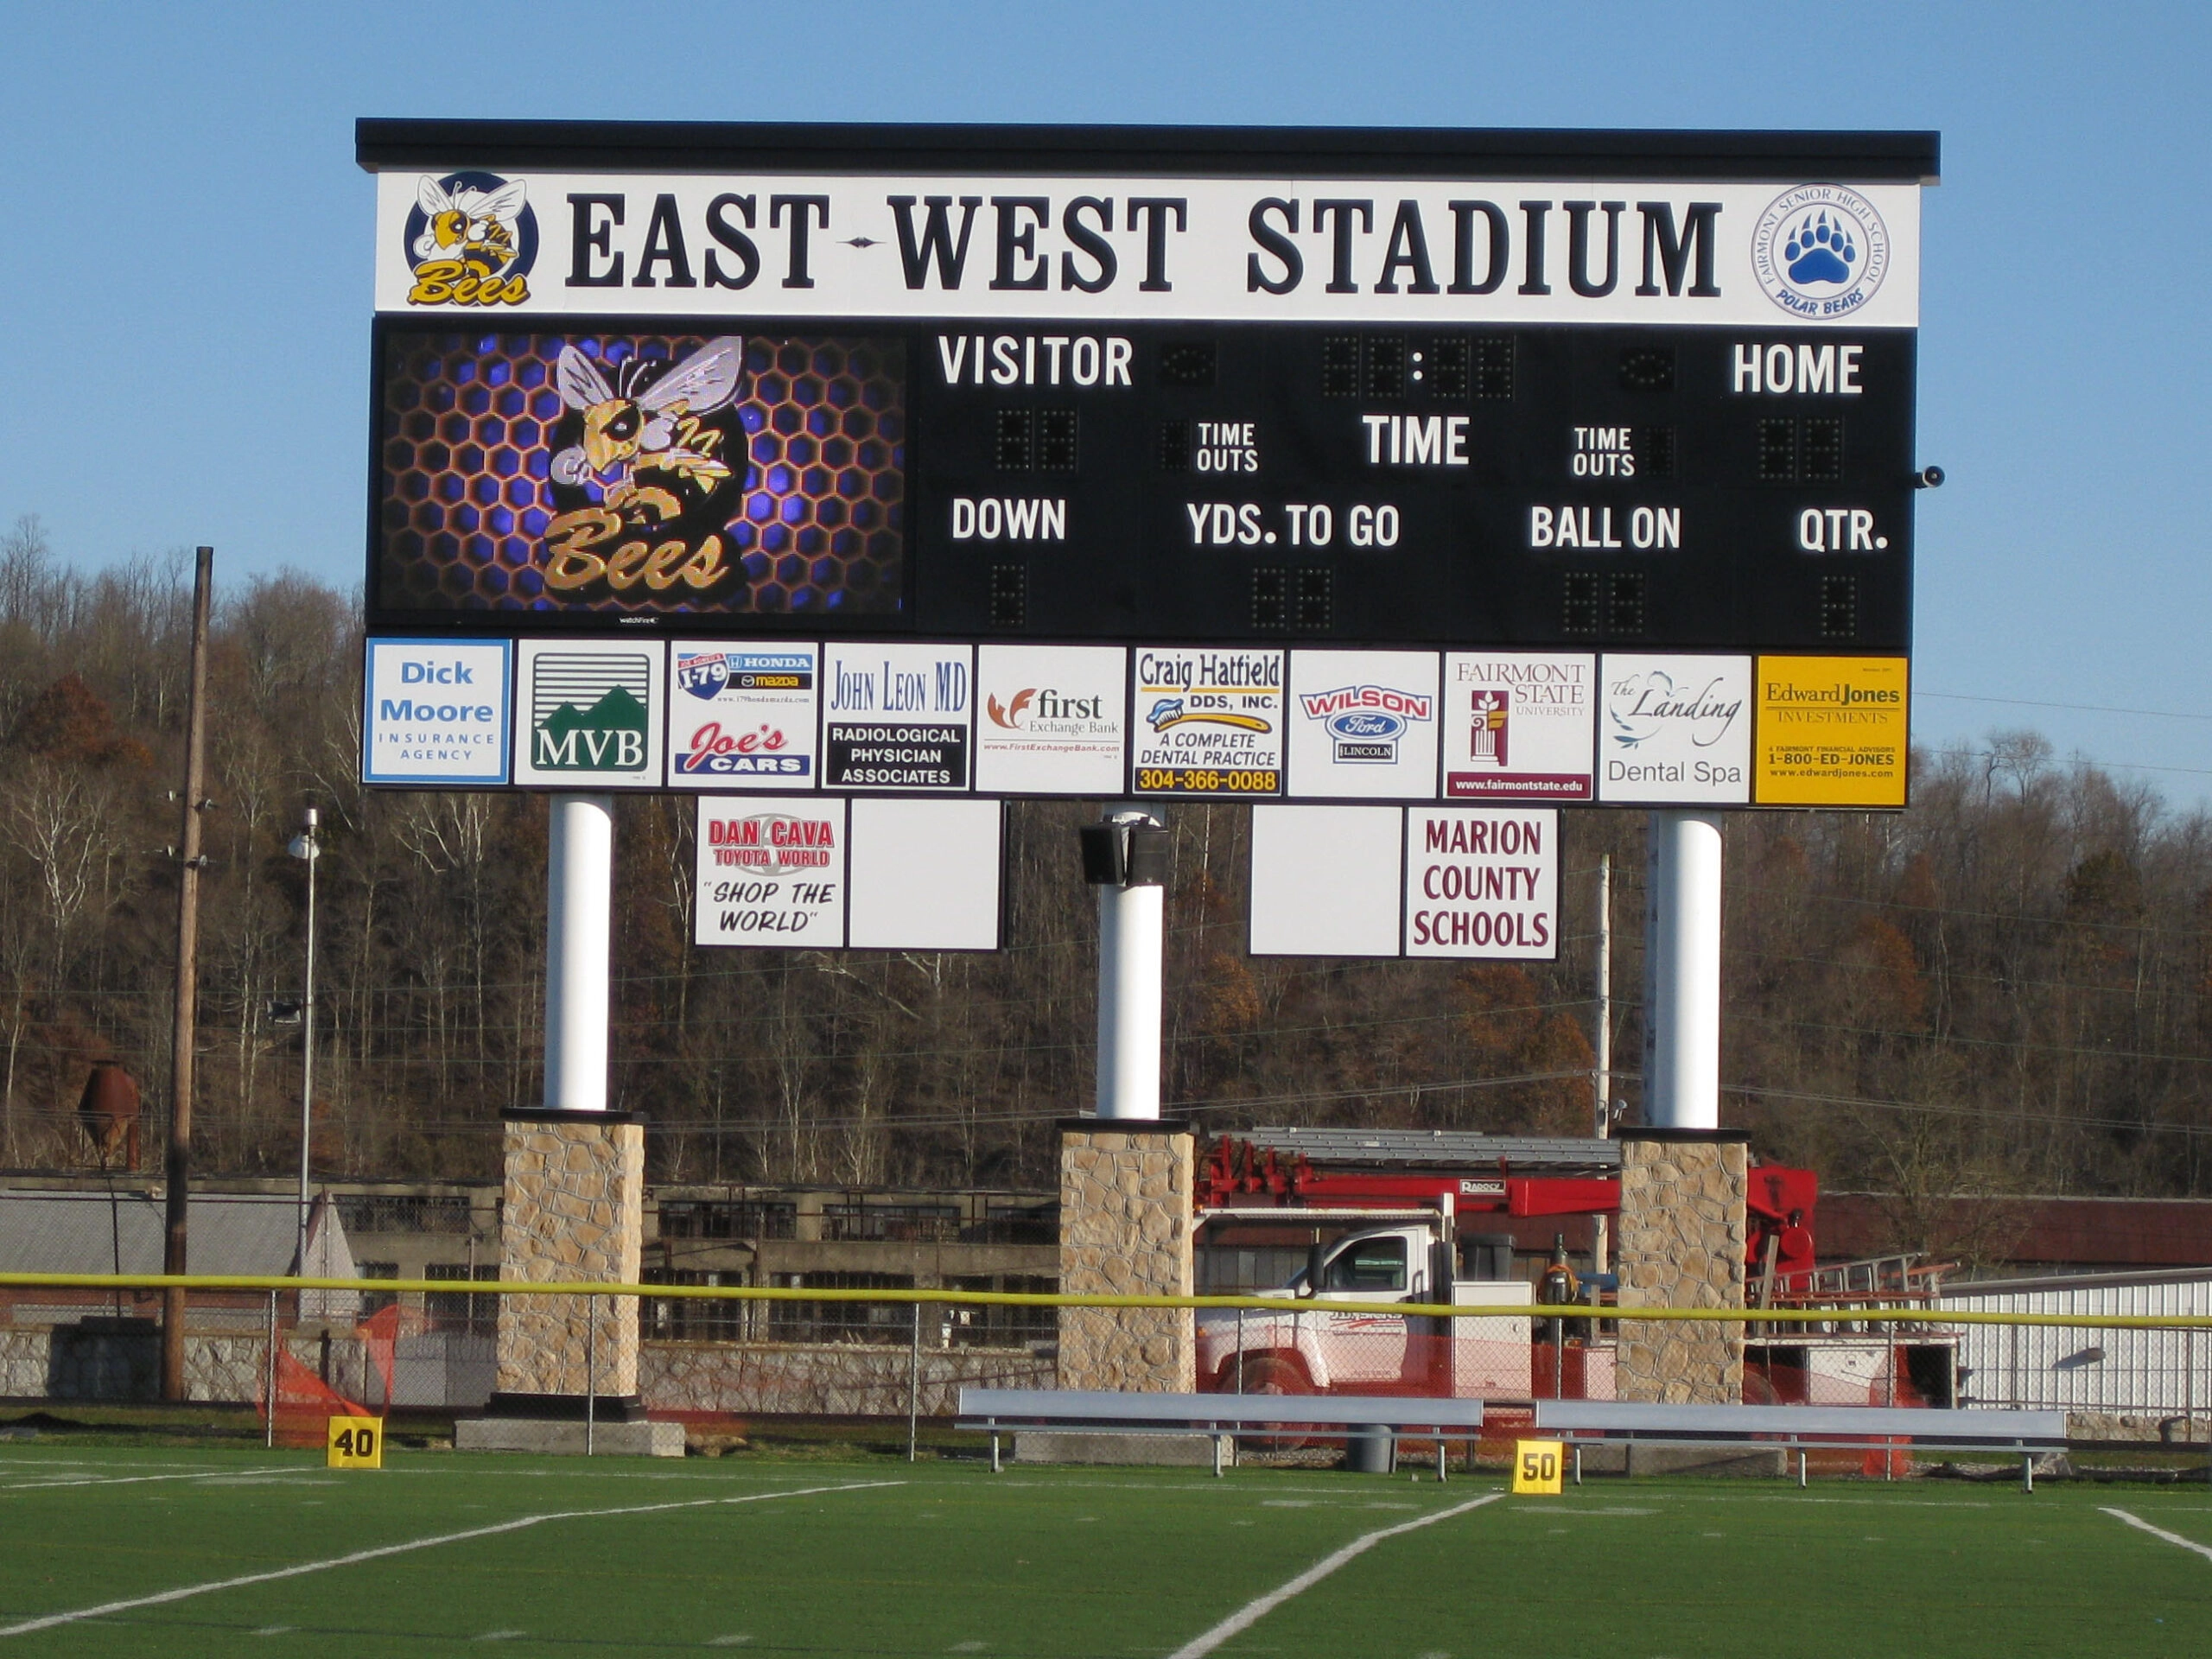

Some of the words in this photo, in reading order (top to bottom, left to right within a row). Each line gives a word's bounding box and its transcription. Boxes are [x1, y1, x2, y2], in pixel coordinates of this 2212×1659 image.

[565, 194, 830, 289] EAST
[887, 195, 1187, 293] WEST
[1247, 197, 1723, 296] STADIUM
[1757, 212, 1778, 284] FAIRMONT
[1779, 188, 1831, 211] SENIOR
[1837, 192, 1871, 219] HIGH
[1866, 222, 1884, 283] SCHOOL
[407, 259, 531, 306] Bees
[1776, 289, 1818, 315] POLAR
[1823, 288, 1864, 315] BEARS
[938, 335, 1133, 385] VISITOR
[1734, 344, 1864, 393] HOME
[1198, 423, 1255, 446] TIME
[1363, 415, 1469, 465] TIME
[1573, 427, 1631, 450] TIME
[1197, 448, 1259, 472] OUTS
[1573, 454, 1636, 477] OUTS
[952, 498, 1066, 540] DOWN
[1187, 503, 1277, 545] YDS.
[1286, 505, 1332, 546] TO
[1350, 505, 1400, 546] GO
[1530, 506, 1622, 548] BALL
[1632, 507, 1681, 549] ON
[1800, 508, 1888, 552] QTR.
[544, 507, 729, 589] Bees
[401, 661, 474, 684] Dick
[744, 658, 810, 668] HONDA
[1140, 653, 1192, 692] Craig
[1199, 654, 1280, 686] Hatfield
[1457, 663, 1586, 685] FAIRMONT
[681, 663, 728, 690] I-79
[756, 676, 798, 687] mazda
[935, 662, 966, 712] MD
[1611, 674, 1640, 696] The
[1037, 689, 1103, 719] first
[1190, 695, 1234, 710] DDS,
[1242, 696, 1278, 709] INC.
[1307, 690, 1426, 716] WILSON
[1515, 684, 1584, 703] STATE
[380, 699, 493, 722] Moore
[1516, 706, 1585, 716] UNIVERSITY
[1628, 677, 1742, 747] Landing
[1778, 711, 1888, 724] INVESTMENTS
[832, 728, 960, 743] RADIOLOGICAL
[1030, 721, 1084, 735] Exchange
[1090, 721, 1118, 734] Bank
[1345, 715, 1385, 733] Ford
[378, 733, 494, 744] INSURANCE
[536, 729, 643, 766] MVB
[686, 722, 788, 769] Joe's
[984, 743, 1120, 753] www.FirstExchangeBank.com
[1160, 733, 1170, 747] A
[1175, 733, 1255, 747] COMPLETE
[400, 749, 472, 760] AGENCY
[851, 748, 942, 763] PHYSICIAN
[1141, 750, 1198, 765] DENTAL
[1203, 751, 1275, 766] PRACTICE
[1344, 747, 1391, 756] LINCOLN
[1769, 753, 1895, 766] 1-800-ED-JONES
[710, 758, 801, 772] CARS
[842, 768, 950, 784] ASSOCIATES
[1608, 760, 1684, 782] Dental
[1694, 760, 1741, 786] Spa
[1770, 768, 1893, 778] www.edwardjones.com
[1140, 769, 1276, 791] 304-366-0088
[1456, 779, 1583, 791] www.fairmontstate.edu
[709, 819, 760, 846] DAN
[771, 820, 835, 848] CAVA
[1426, 820, 1541, 855] MARION
[713, 849, 771, 866] TOYOTA
[778, 849, 830, 868] WORLD
[792, 883, 836, 904] THE
[1423, 865, 1541, 900] COUNTY
[1414, 911, 1549, 947] SCHOOLS
[334, 1428, 373, 1457] 40
[1523, 1453, 1555, 1481] 50
